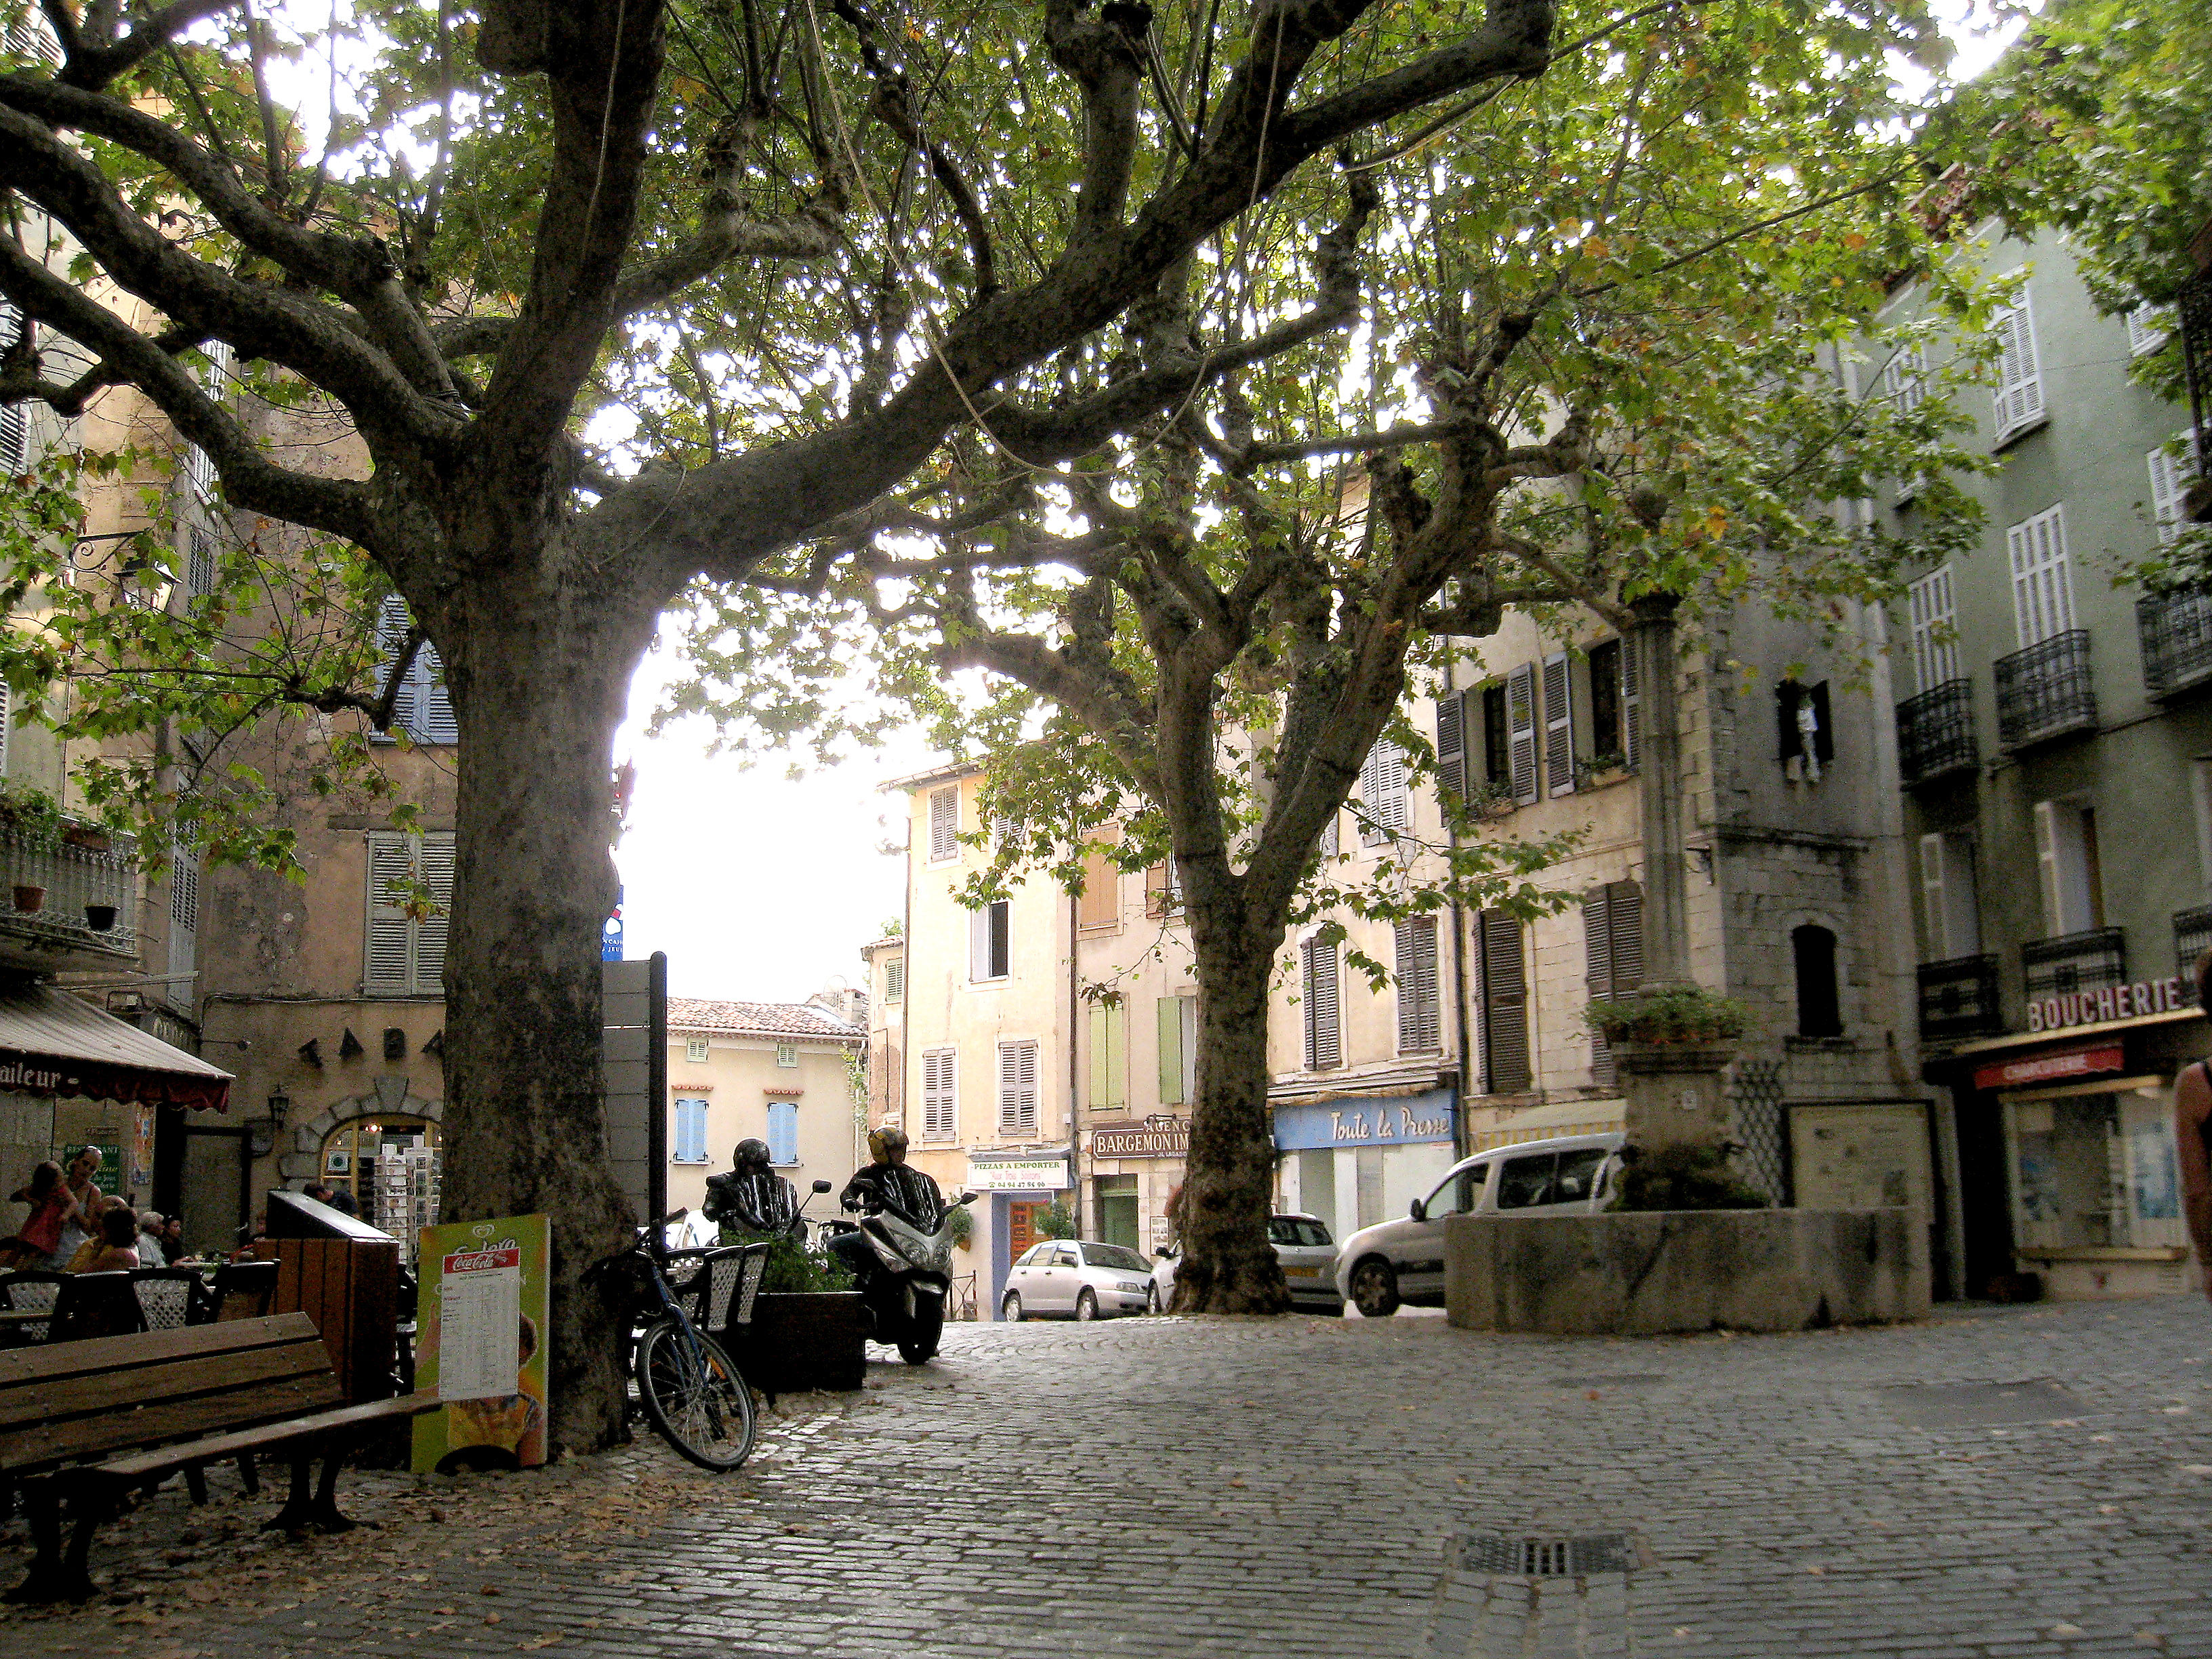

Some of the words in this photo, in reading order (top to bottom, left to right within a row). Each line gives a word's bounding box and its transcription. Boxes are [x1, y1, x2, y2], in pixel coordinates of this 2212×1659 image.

[2027, 975, 2184, 1033] BOUCHERIE
[298, 1027, 445, 1068] TABA
[0, 1061, 62, 1088] aileur
[1146, 1120, 1190, 1132] AGENC
[1331, 1111, 1371, 1141] Toute
[1378, 1108, 1395, 1138] la
[1401, 1107, 1450, 1136] Presse
[1097, 1134, 1171, 1153] BARGEMON
[1174, 1133, 1189, 1150] IM
